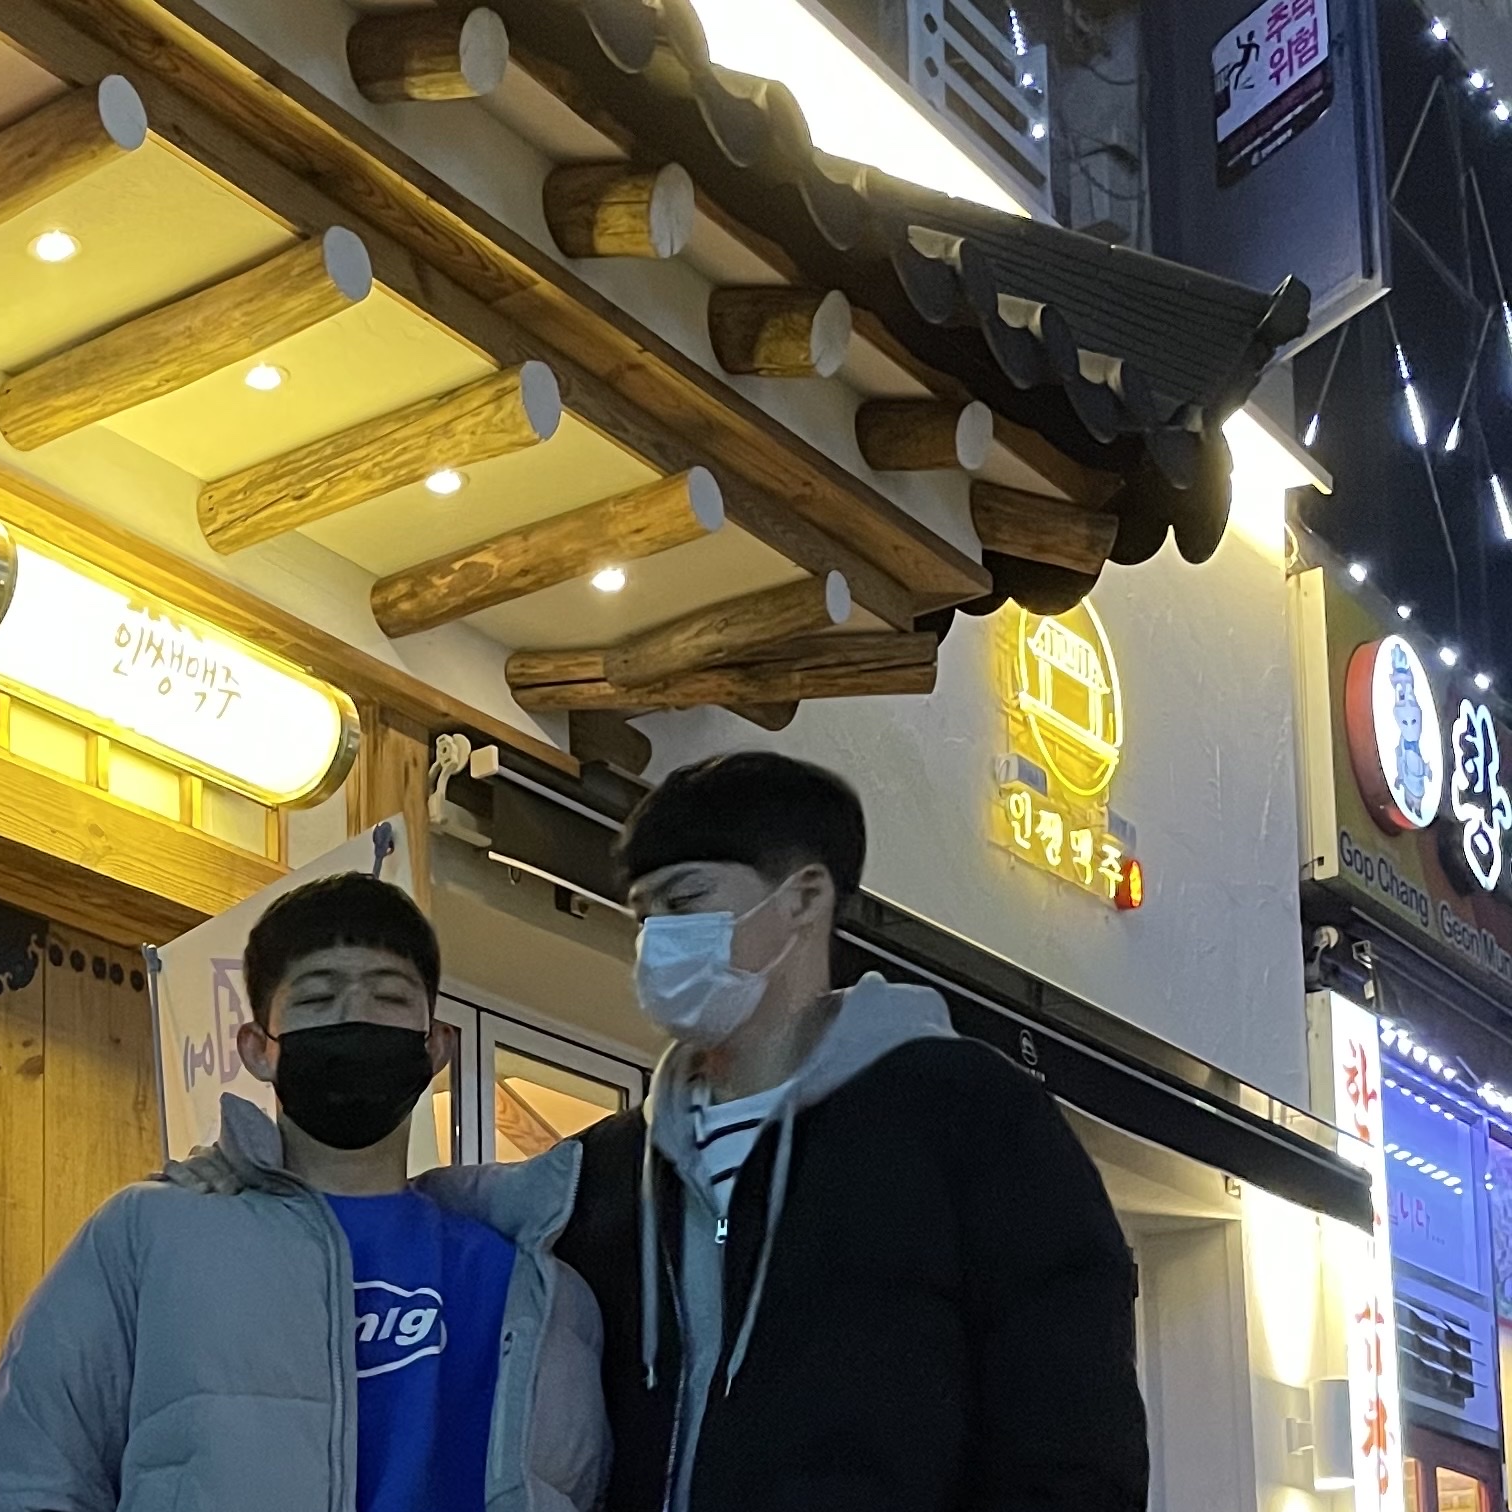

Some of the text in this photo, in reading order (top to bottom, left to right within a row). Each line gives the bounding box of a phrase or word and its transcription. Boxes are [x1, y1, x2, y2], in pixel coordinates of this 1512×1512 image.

[1268, 17, 1319, 86] 위험
[112, 622, 242, 720] 인쌩맥주
[1339, 830, 1375, 887] Gop
[1377, 857, 1430, 929] Chang
[1440, 903, 1480, 957] Geon
